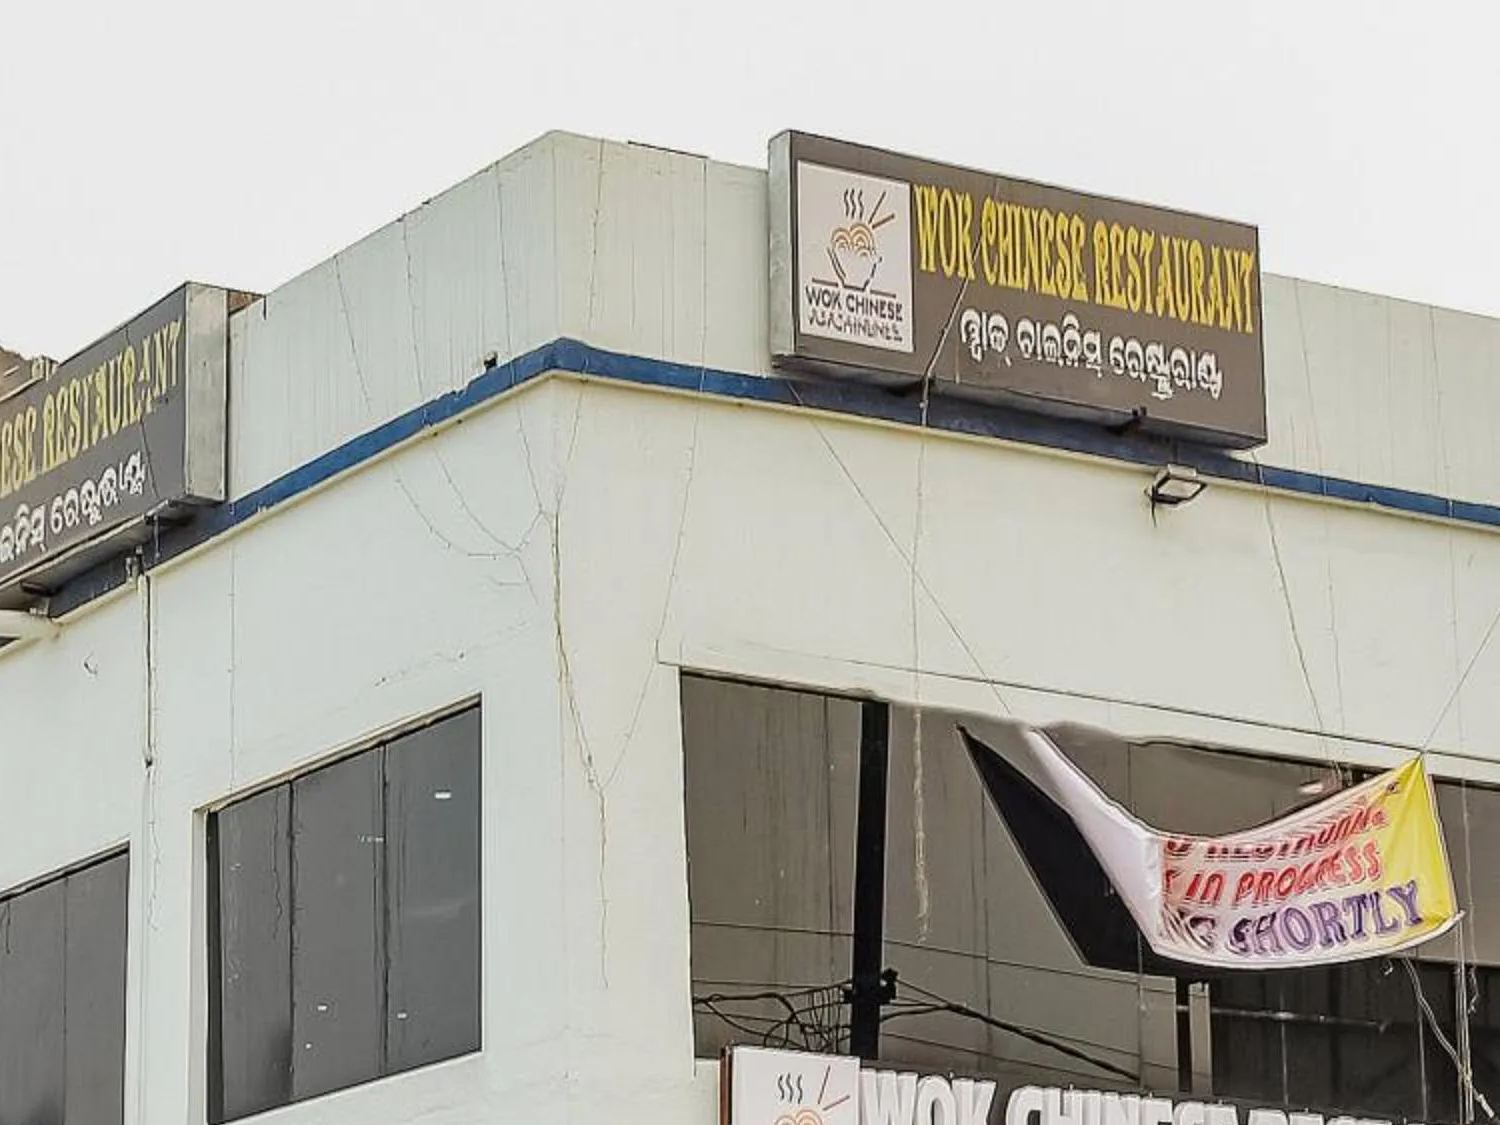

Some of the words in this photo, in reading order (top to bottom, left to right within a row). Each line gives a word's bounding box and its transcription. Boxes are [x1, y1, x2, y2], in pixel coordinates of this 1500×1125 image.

[805, 285, 842, 311] WOK
[845, 293, 903, 322] CHINESE
[913, 184, 975, 279] WOK
[981, 196, 1088, 302] CHINESE
[1093, 220, 1254, 334] RESTAURANT
[42, 320, 184, 475] RESTAURANT
